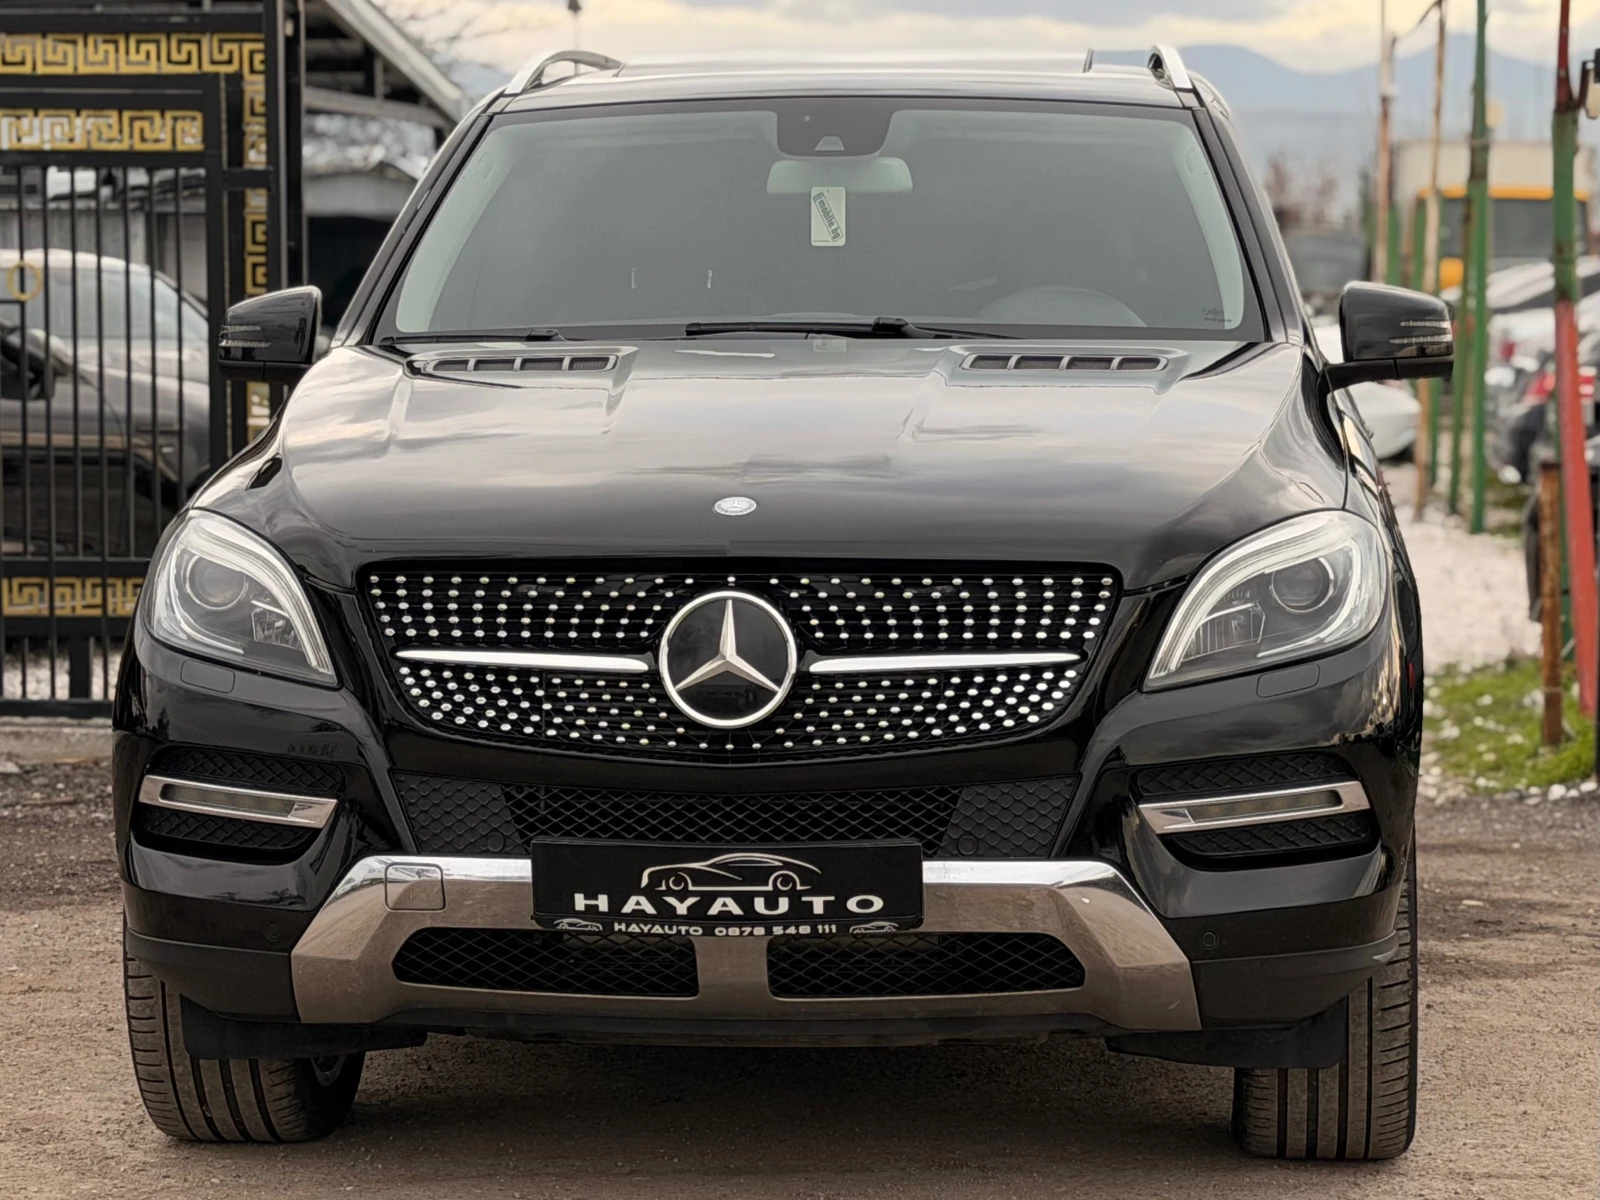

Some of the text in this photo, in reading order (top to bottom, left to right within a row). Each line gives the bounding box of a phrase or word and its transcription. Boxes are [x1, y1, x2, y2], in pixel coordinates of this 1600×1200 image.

[817, 199, 841, 240] mobile.bg
[574, 893, 884, 916] HAYAUTO
[613, 922, 704, 936] HAYAUTO
[816, 924, 837, 934] 111
